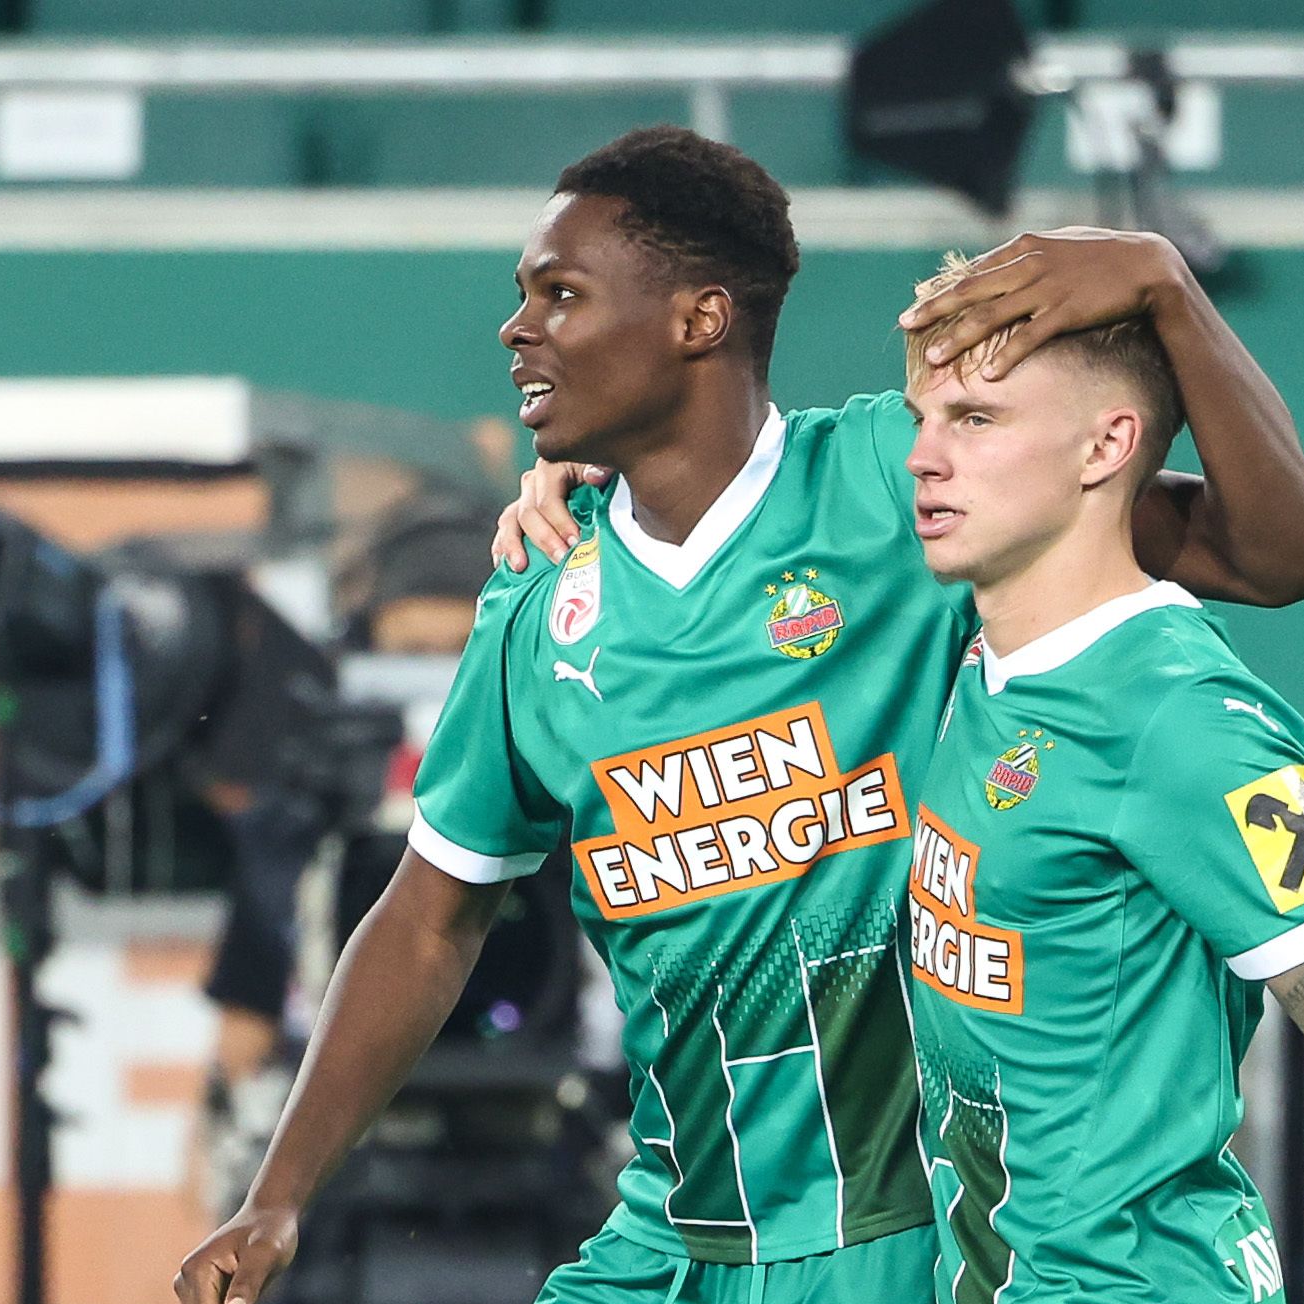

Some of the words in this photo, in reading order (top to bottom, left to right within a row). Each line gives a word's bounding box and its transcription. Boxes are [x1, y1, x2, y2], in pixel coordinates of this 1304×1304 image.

[773, 606, 836, 640] RAPID
[607, 716, 825, 824] WIEN
[589, 768, 896, 908] ENERGIE
